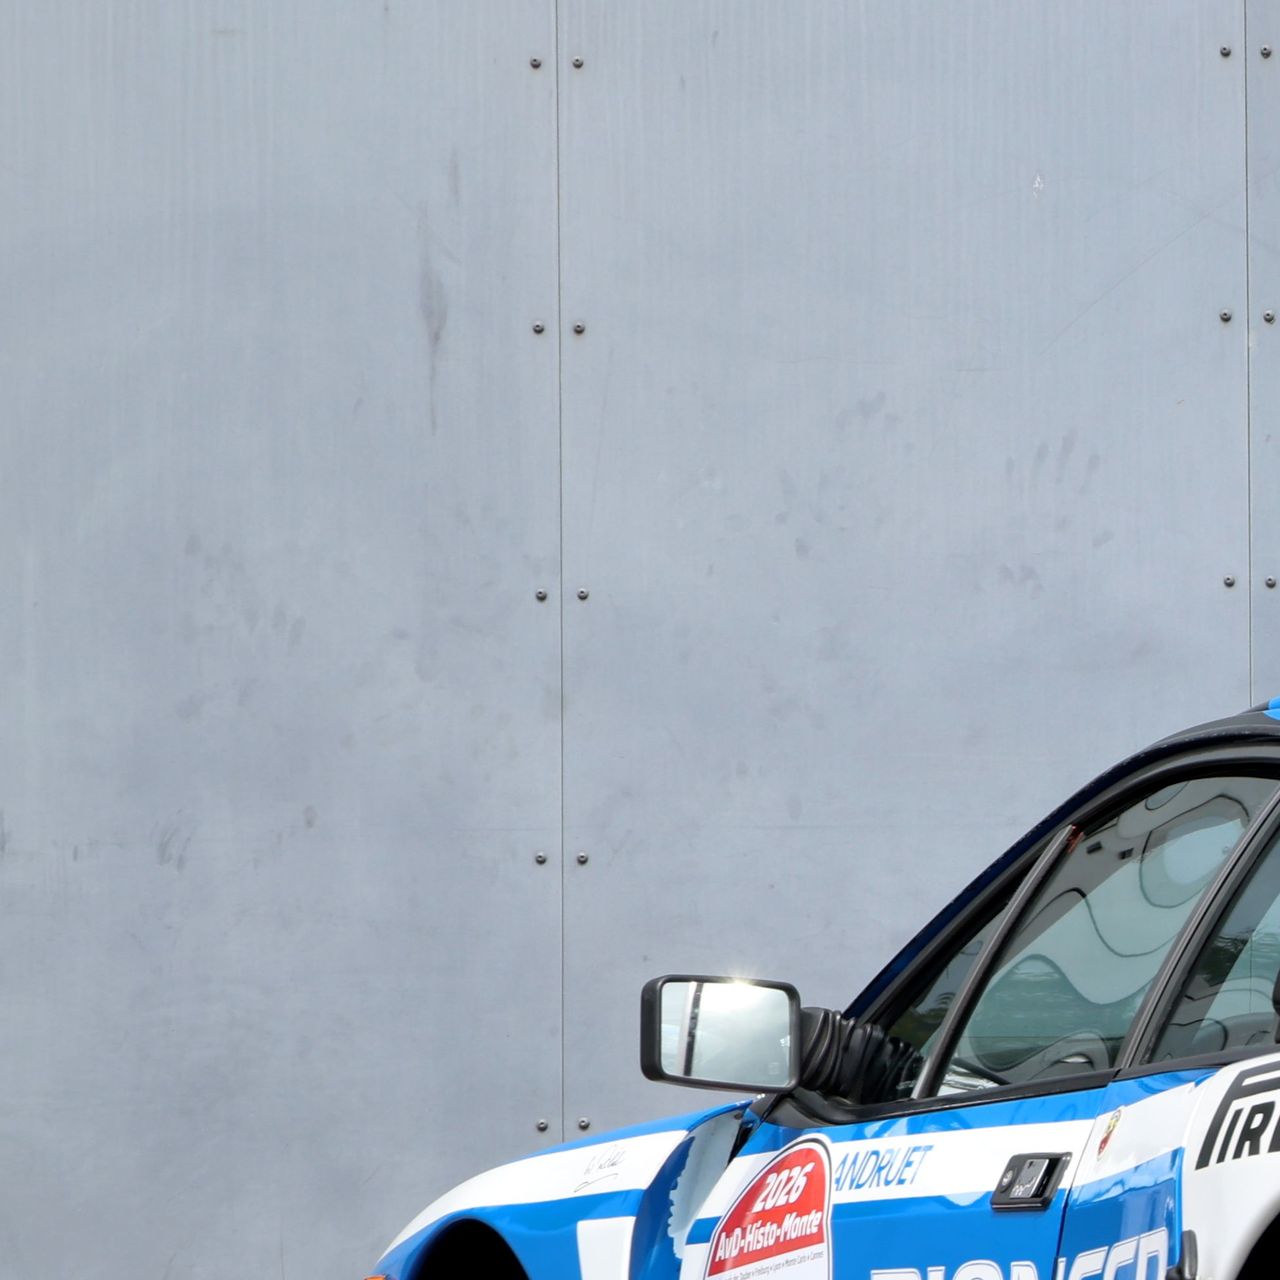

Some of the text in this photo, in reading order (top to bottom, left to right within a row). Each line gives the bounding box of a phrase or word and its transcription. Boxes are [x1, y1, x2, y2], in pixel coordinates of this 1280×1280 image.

[751, 1161, 816, 1214] 2026
[834, 1144, 934, 1192] ANDRUET
[715, 1208, 824, 1263] AvD-Histo-Monte
